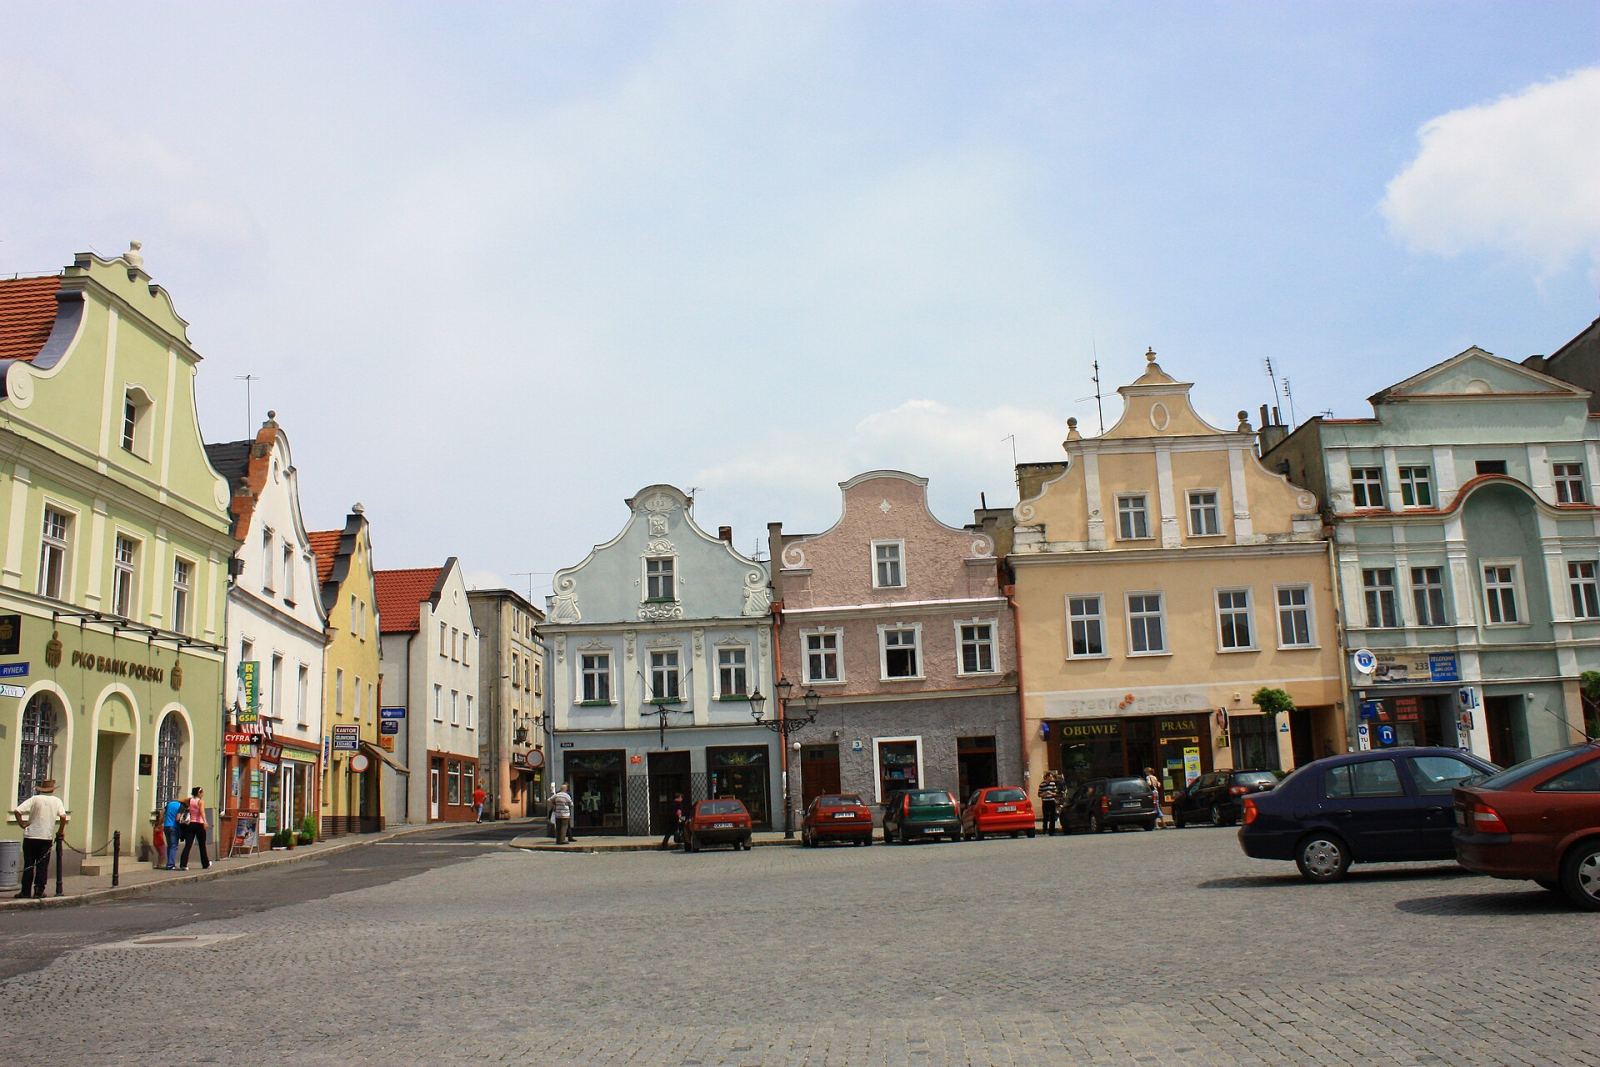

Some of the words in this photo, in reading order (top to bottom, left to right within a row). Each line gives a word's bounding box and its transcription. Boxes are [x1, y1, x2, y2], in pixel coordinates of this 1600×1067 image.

[3, 666, 24, 674] RYNEK
[72, 650, 95, 670] PKO
[97, 655, 128, 677] BANK
[129, 662, 164, 684] POLSKI
[1063, 724, 1118, 736] OBUWIE
[1161, 720, 1195, 731] PRASA
[225, 734, 250, 742] CYFRA
